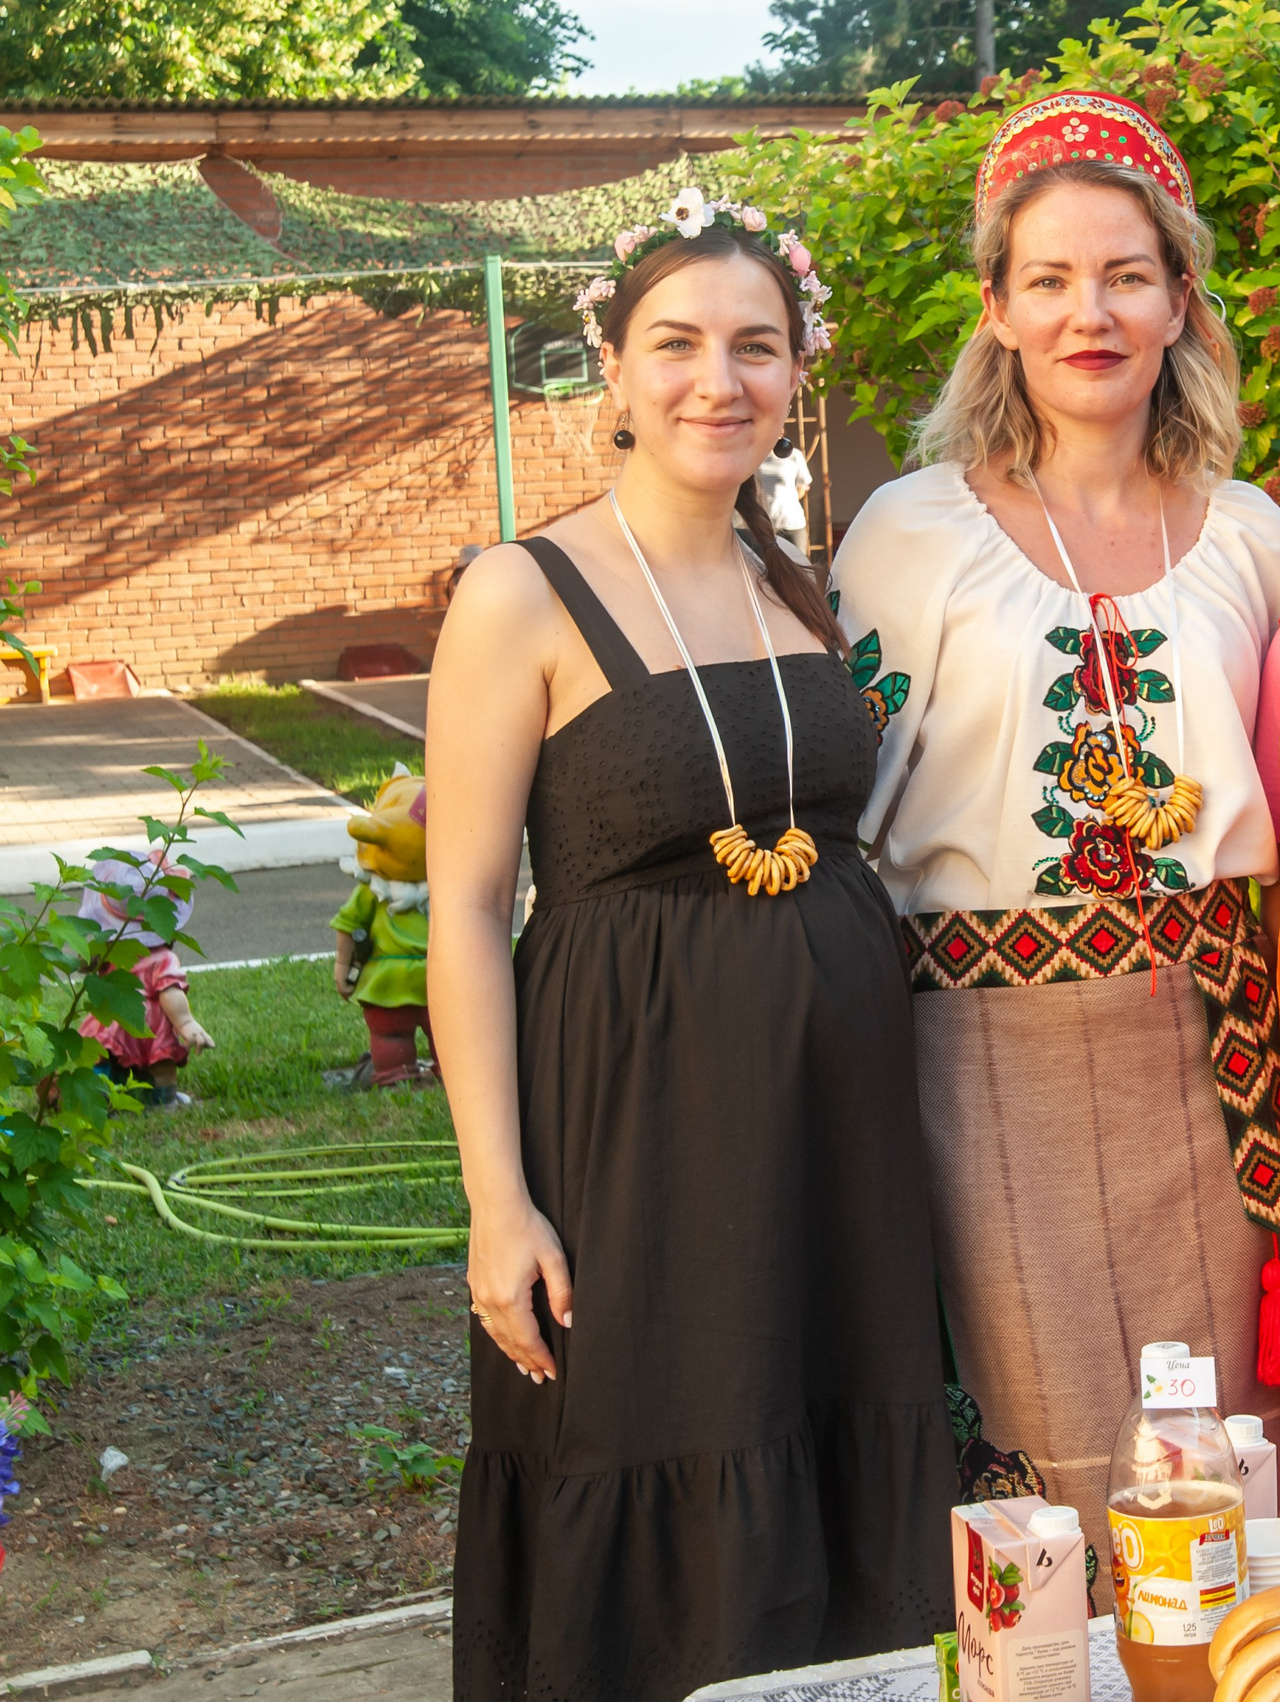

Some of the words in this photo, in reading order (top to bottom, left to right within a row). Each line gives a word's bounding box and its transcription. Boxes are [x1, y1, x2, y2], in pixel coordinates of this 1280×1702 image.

[1166, 1360, 1190, 1372] Цена
[1167, 1378, 1196, 1397] 30
[1182, 1622, 1197, 1633] 1,25
[958, 1611, 994, 1678] Морс
